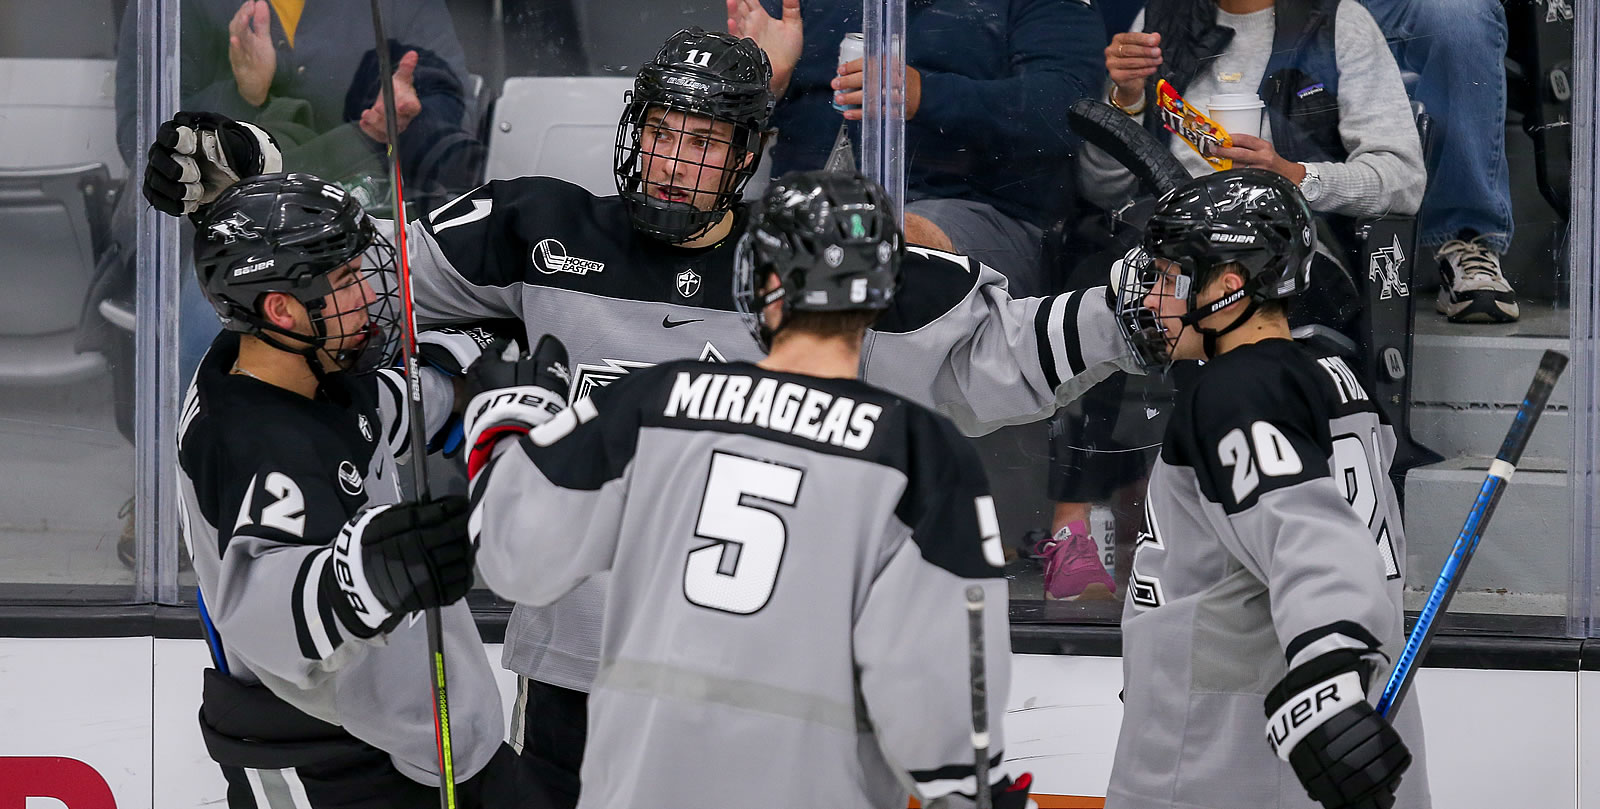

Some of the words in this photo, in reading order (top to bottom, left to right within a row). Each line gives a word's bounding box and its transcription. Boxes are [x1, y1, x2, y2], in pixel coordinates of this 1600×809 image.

[683, 49, 712, 67] 11
[1210, 233, 1256, 244] BAUER
[234, 259, 275, 277] BAUER
[561, 263, 587, 274] EAST
[564, 256, 604, 271] HOCKEY
[851, 277, 868, 303] 5
[1211, 289, 1245, 312] BAUER
[409, 357, 421, 402] BAUER
[664, 372, 883, 451] MIRAGEAS
[1217, 420, 1303, 505] 20
[232, 471, 307, 538] 12
[682, 449, 807, 617] 5
[1104, 520, 1115, 567] RISE
